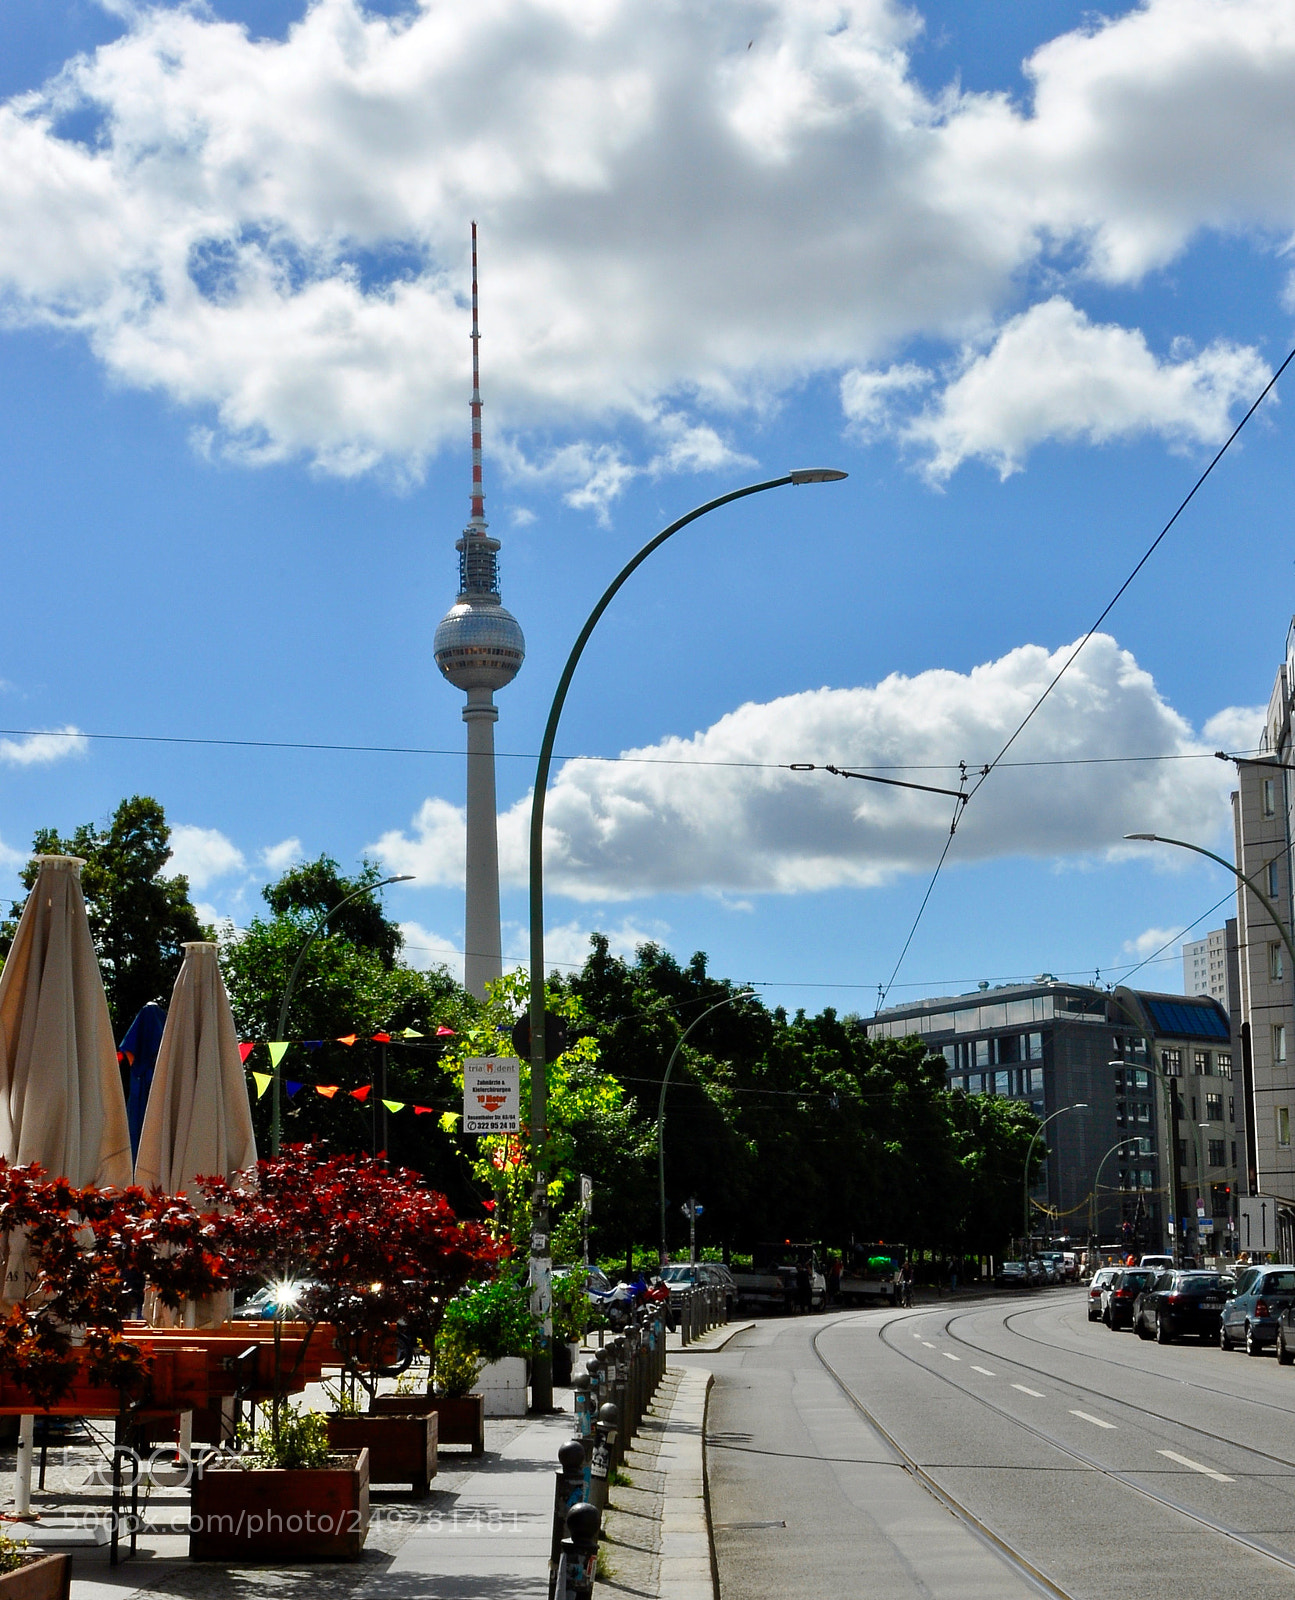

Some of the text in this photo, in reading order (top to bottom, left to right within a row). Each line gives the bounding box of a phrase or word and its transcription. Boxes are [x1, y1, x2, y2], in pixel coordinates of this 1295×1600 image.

[468, 1064, 515, 1072] tria dent
[477, 1095, 507, 1103] 10 Meter
[477, 1122, 516, 1130] 322 95 24 10
